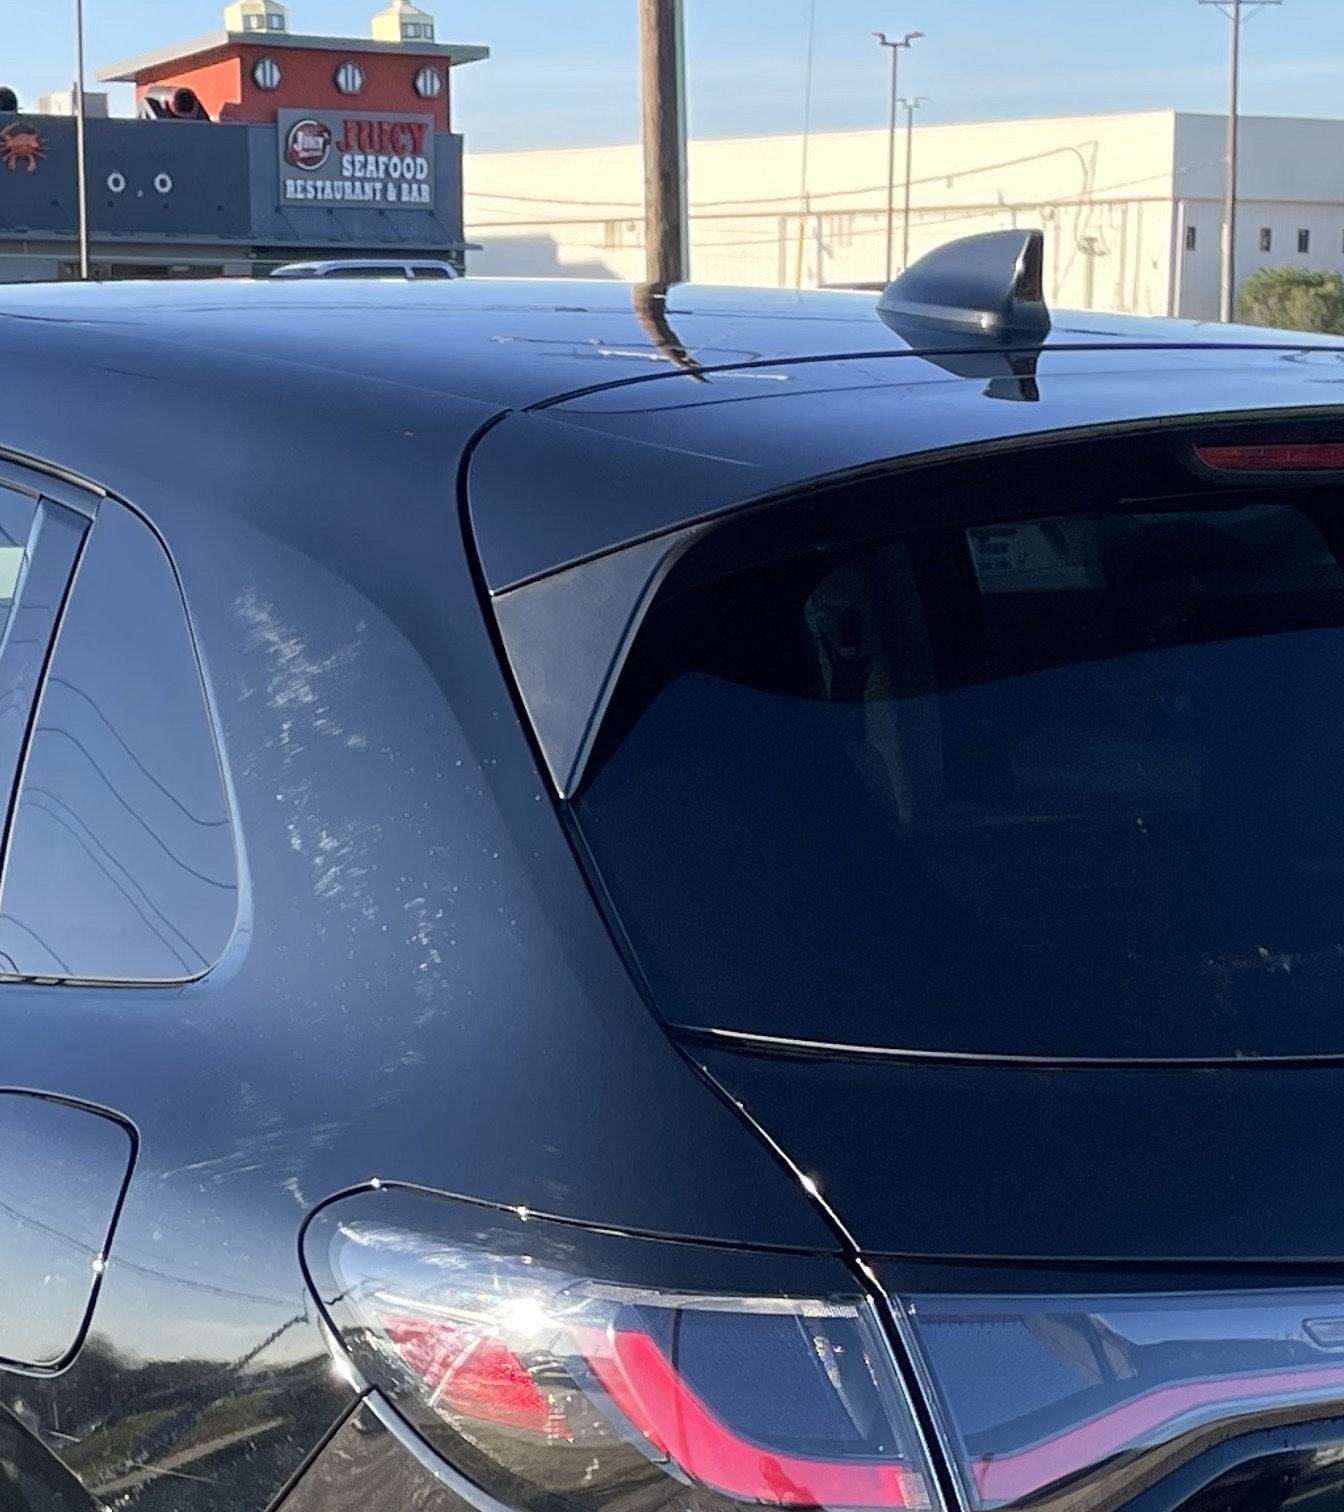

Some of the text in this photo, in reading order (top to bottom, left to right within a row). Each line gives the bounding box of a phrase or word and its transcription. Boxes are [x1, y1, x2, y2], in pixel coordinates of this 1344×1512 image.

[336, 119, 429, 154] JUICY
[342, 154, 429, 180] SEAFOOD
[285, 179, 430, 203] RESTAURANT & BAR
